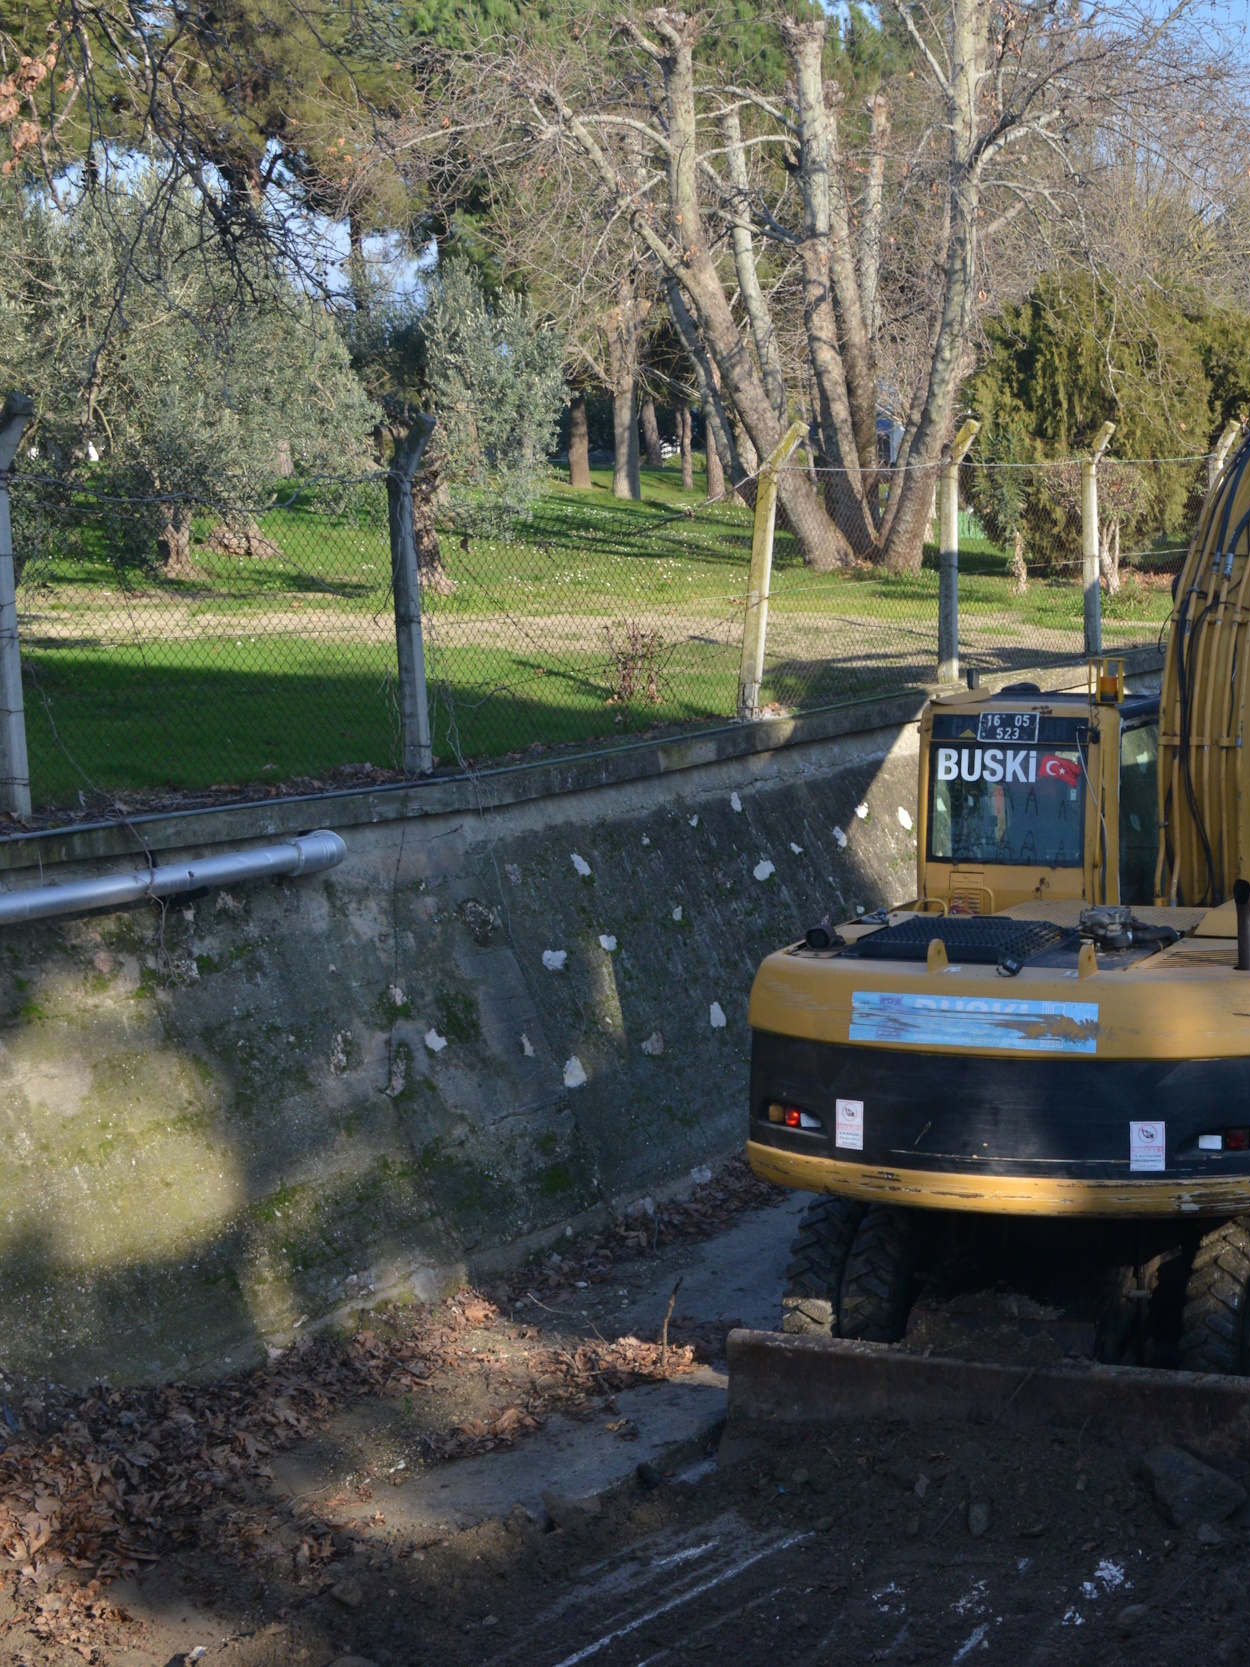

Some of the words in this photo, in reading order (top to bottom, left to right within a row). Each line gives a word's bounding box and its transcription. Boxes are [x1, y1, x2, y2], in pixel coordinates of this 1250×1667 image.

[987, 714, 1001, 727] 16
[1014, 714, 1030, 727] 05
[995, 727, 1020, 740] 523
